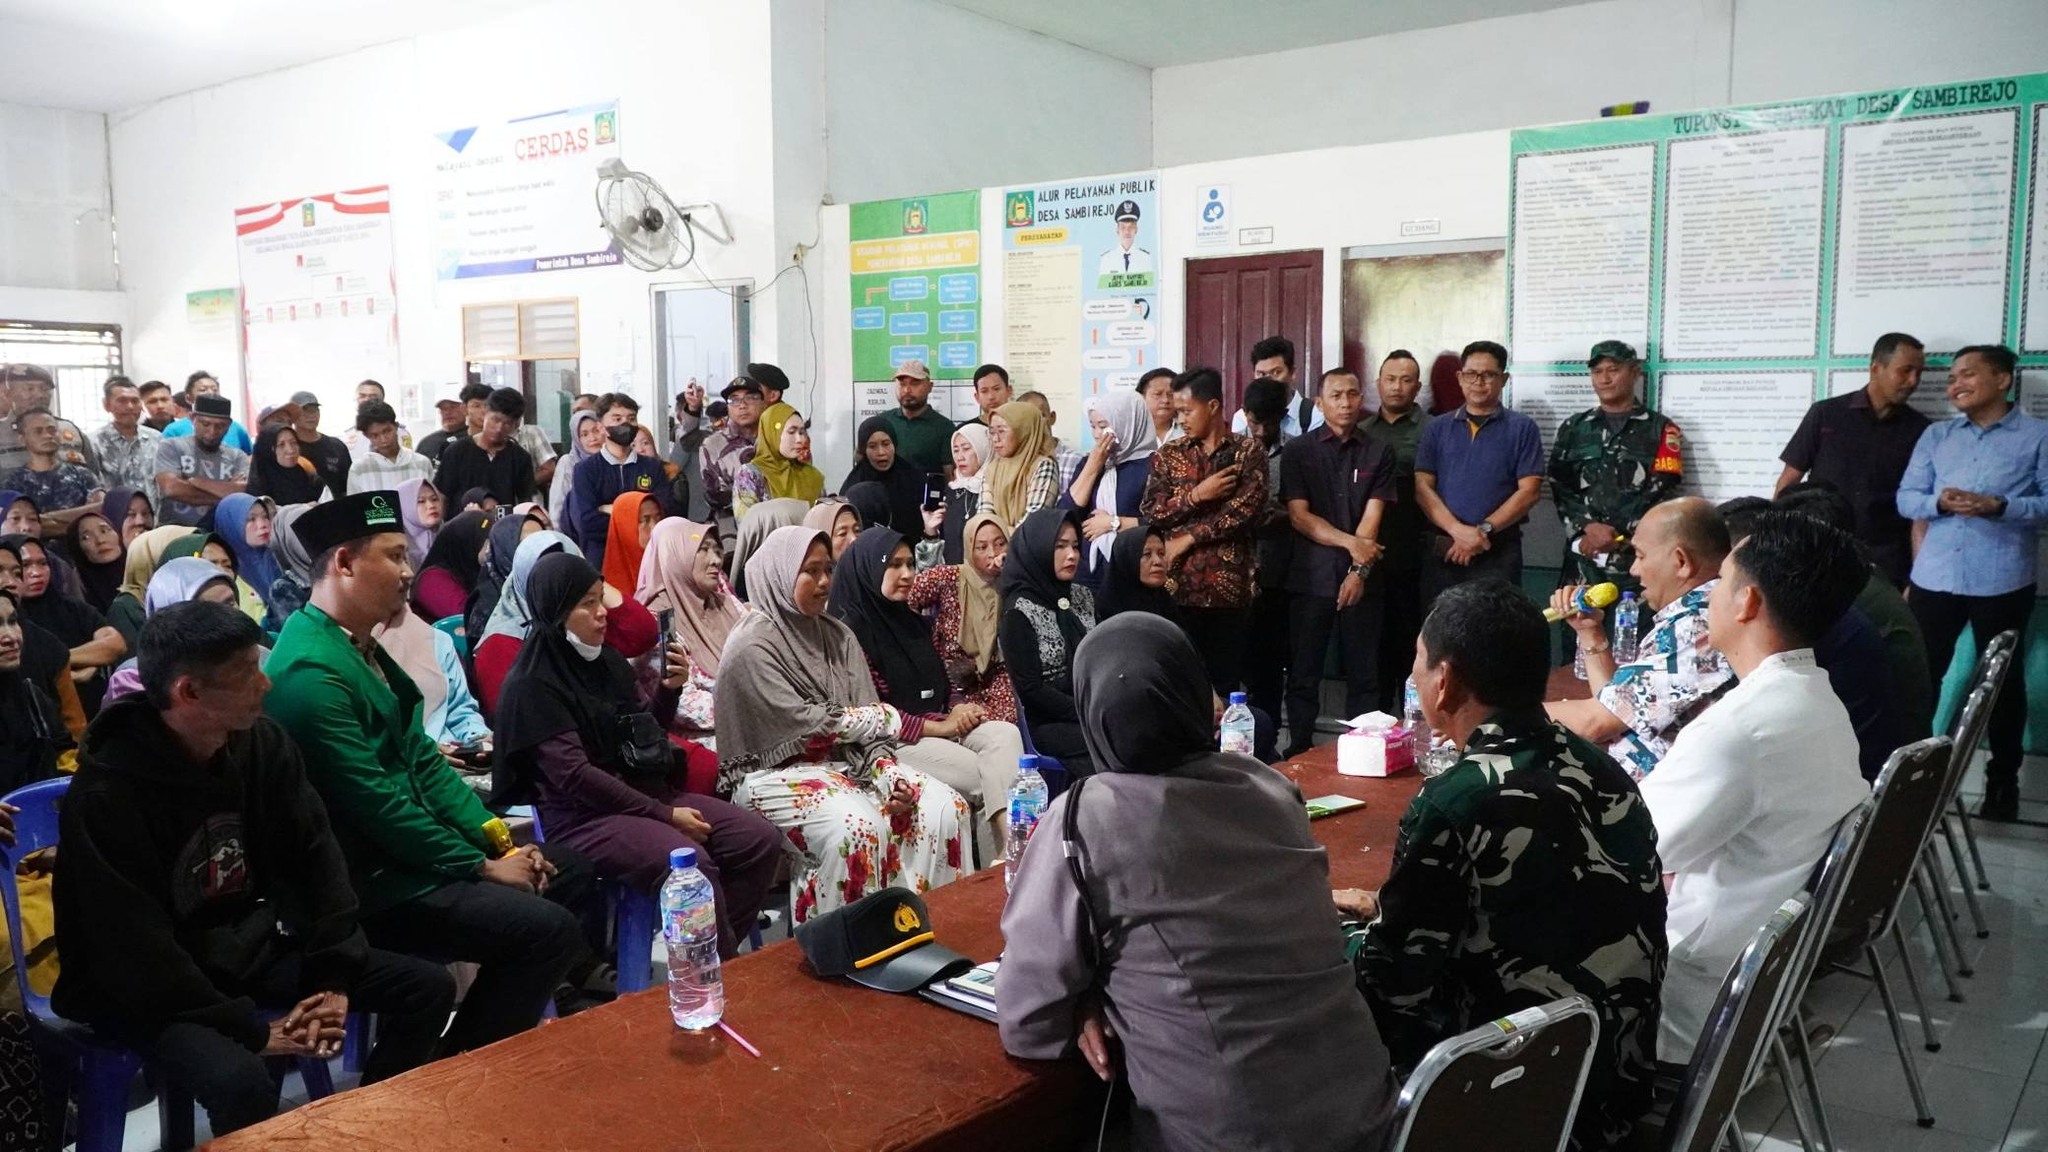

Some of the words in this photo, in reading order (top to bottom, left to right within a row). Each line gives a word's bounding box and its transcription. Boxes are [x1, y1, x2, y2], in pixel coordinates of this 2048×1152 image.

[1856, 94, 1901, 115] DESA
[1912, 79, 2018, 110] SAMBIREJO
[514, 127, 589, 161] CERDAS
[1038, 189, 1060, 203] ALUR
[1064, 183, 1115, 200] PELAYANAN
[1120, 179, 1156, 195] PUBLIK
[1038, 209, 1060, 223] DESA
[1064, 203, 1115, 220] SAMBIREJO
[586, 252, 617, 264] Sambirejo
